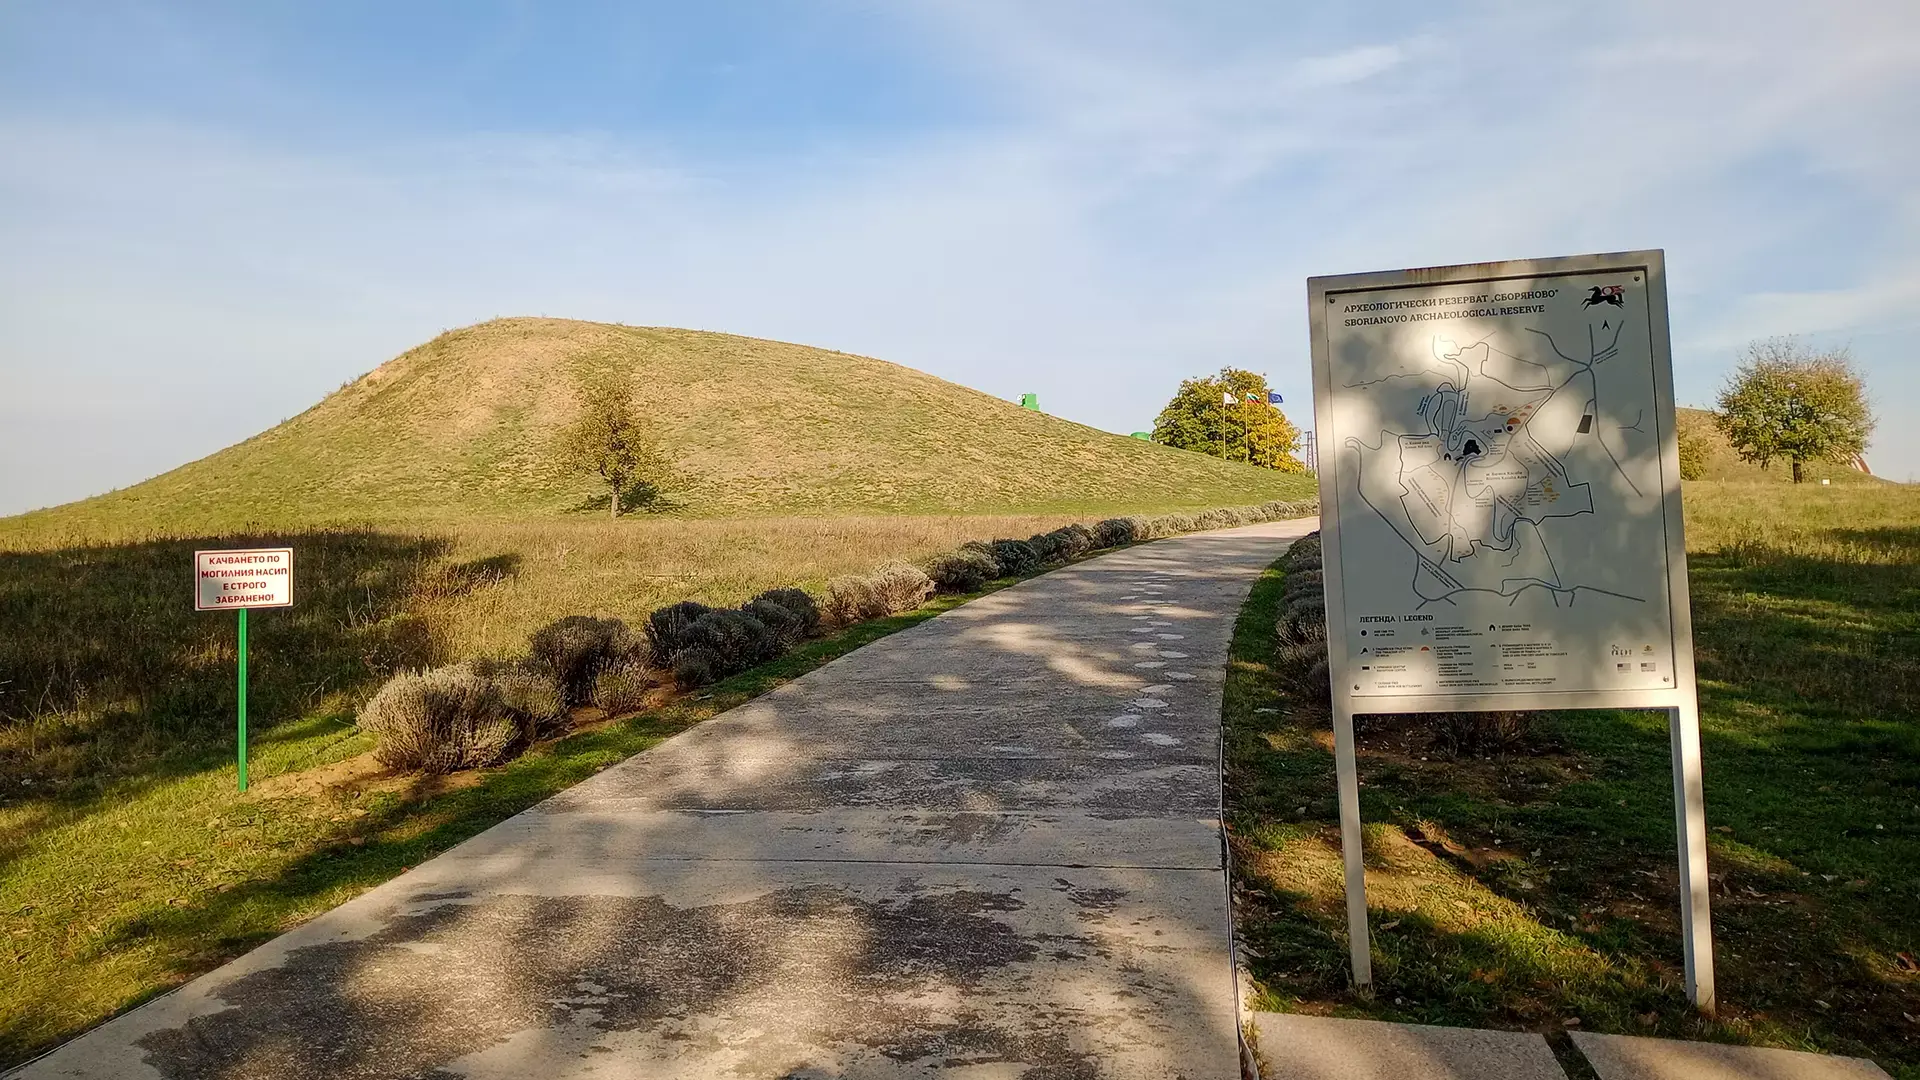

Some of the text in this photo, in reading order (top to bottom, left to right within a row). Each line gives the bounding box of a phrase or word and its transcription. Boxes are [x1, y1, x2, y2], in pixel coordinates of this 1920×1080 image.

[1344, 299, 1436, 313] АРХЕОЛОГИЧЕСКИ
[1438, 294, 1488, 305] РЕЗЕРВАТ
[1344, 304, 1545, 327] SBORIANOVO ARCHAEOLOGICAL RESERVE
[209, 555, 280, 565] КАЧВАНЕТО ПО
[201, 568, 287, 579] МОГИЛНИЯ НАСИП
[231, 581, 267, 590] СТРОГО
[215, 594, 274, 604] ЗАБРАНЕНО!
[1360, 614, 1434, 623] ЛЕГЕНДА LEGEND
